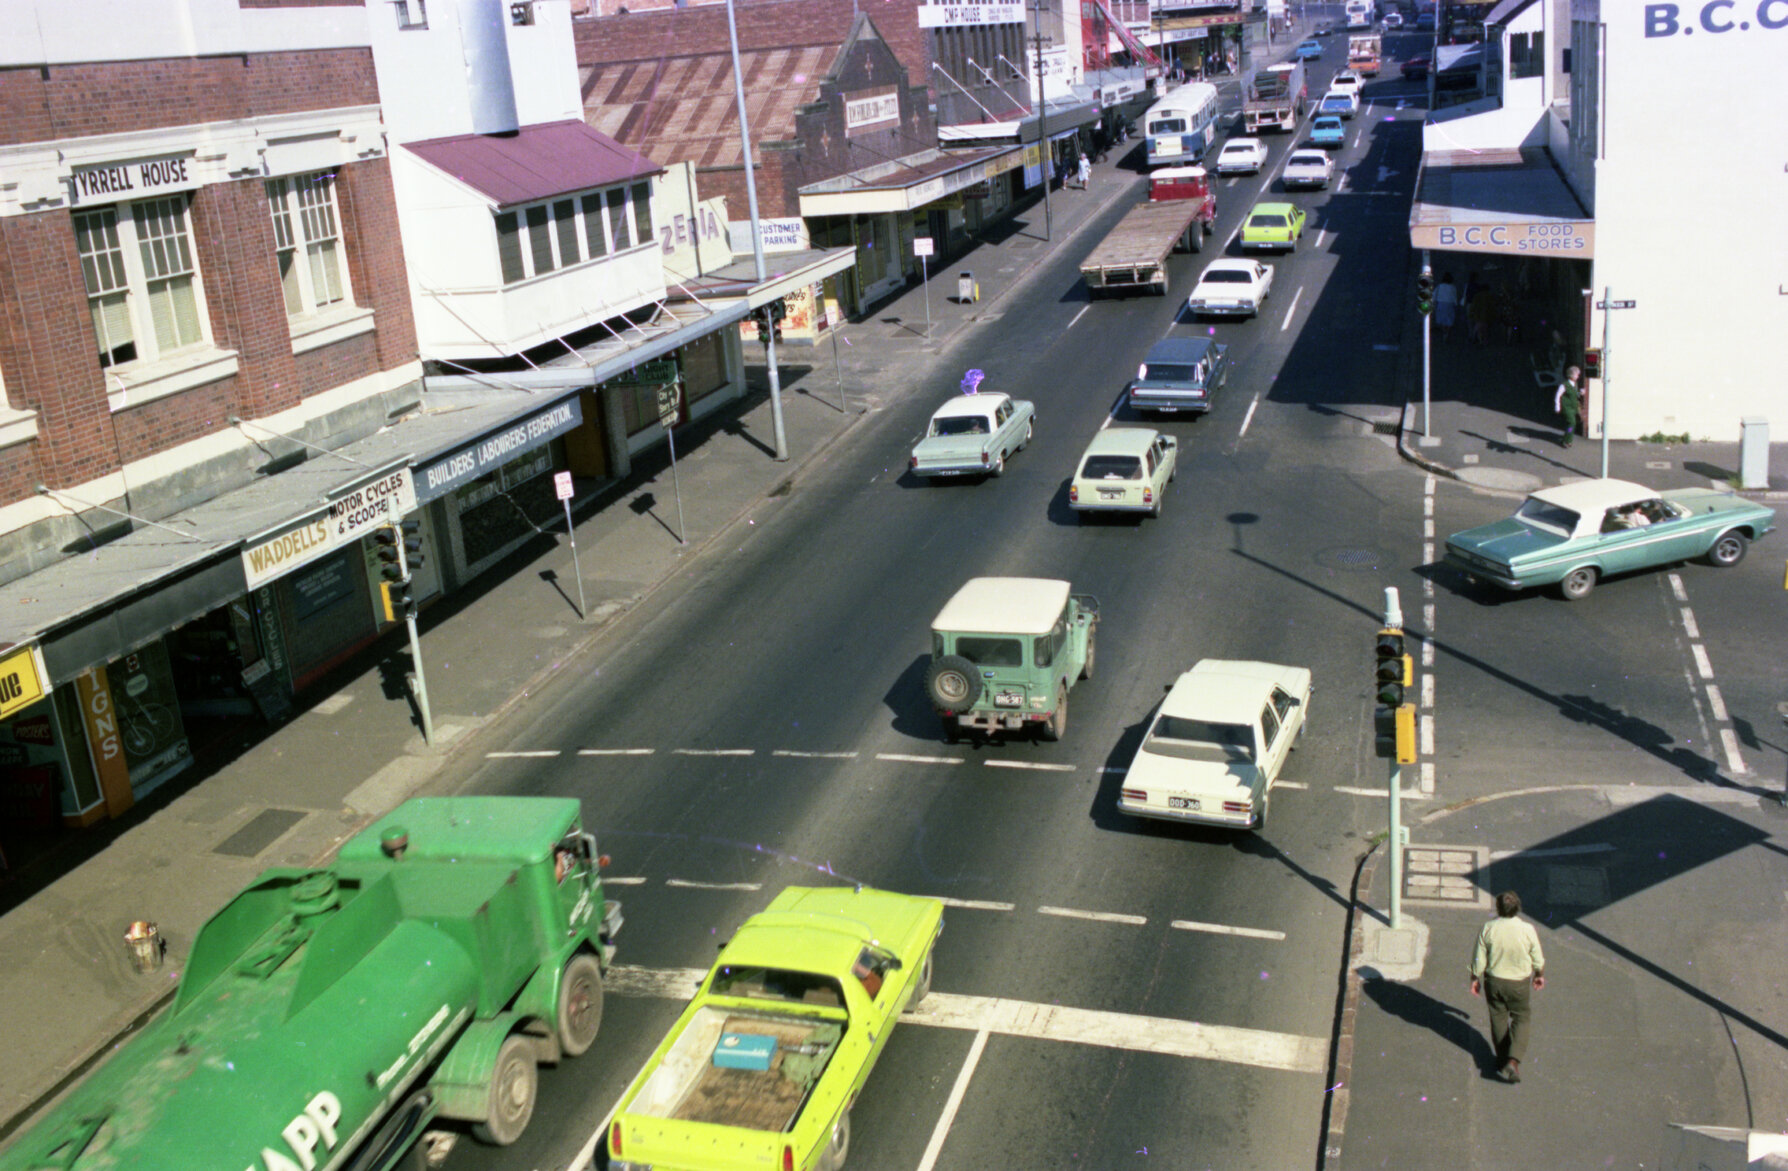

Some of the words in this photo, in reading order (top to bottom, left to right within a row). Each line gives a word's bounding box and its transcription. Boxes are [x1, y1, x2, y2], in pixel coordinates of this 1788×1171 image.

[70, 166, 134, 198] TYRRELL
[141, 159, 188, 187] HOUSE
[764, 234, 798, 245] PARKING
[1439, 226, 1512, 246] B.C.C.
[1518, 237, 1585, 250] STORES
[1528, 225, 1574, 237] FOOD
[427, 451, 475, 490] BUILDERS
[477, 426, 527, 466] LABOURERS
[527, 403, 574, 441] FEDERATION.
[329, 492, 363, 520] MOTOR
[366, 473, 403, 502] CYCLES
[338, 522, 345, 534] &
[0, 672, 23, 705] ue
[88, 670, 120, 761] IGNS
[245, 1090, 342, 1171] APP
